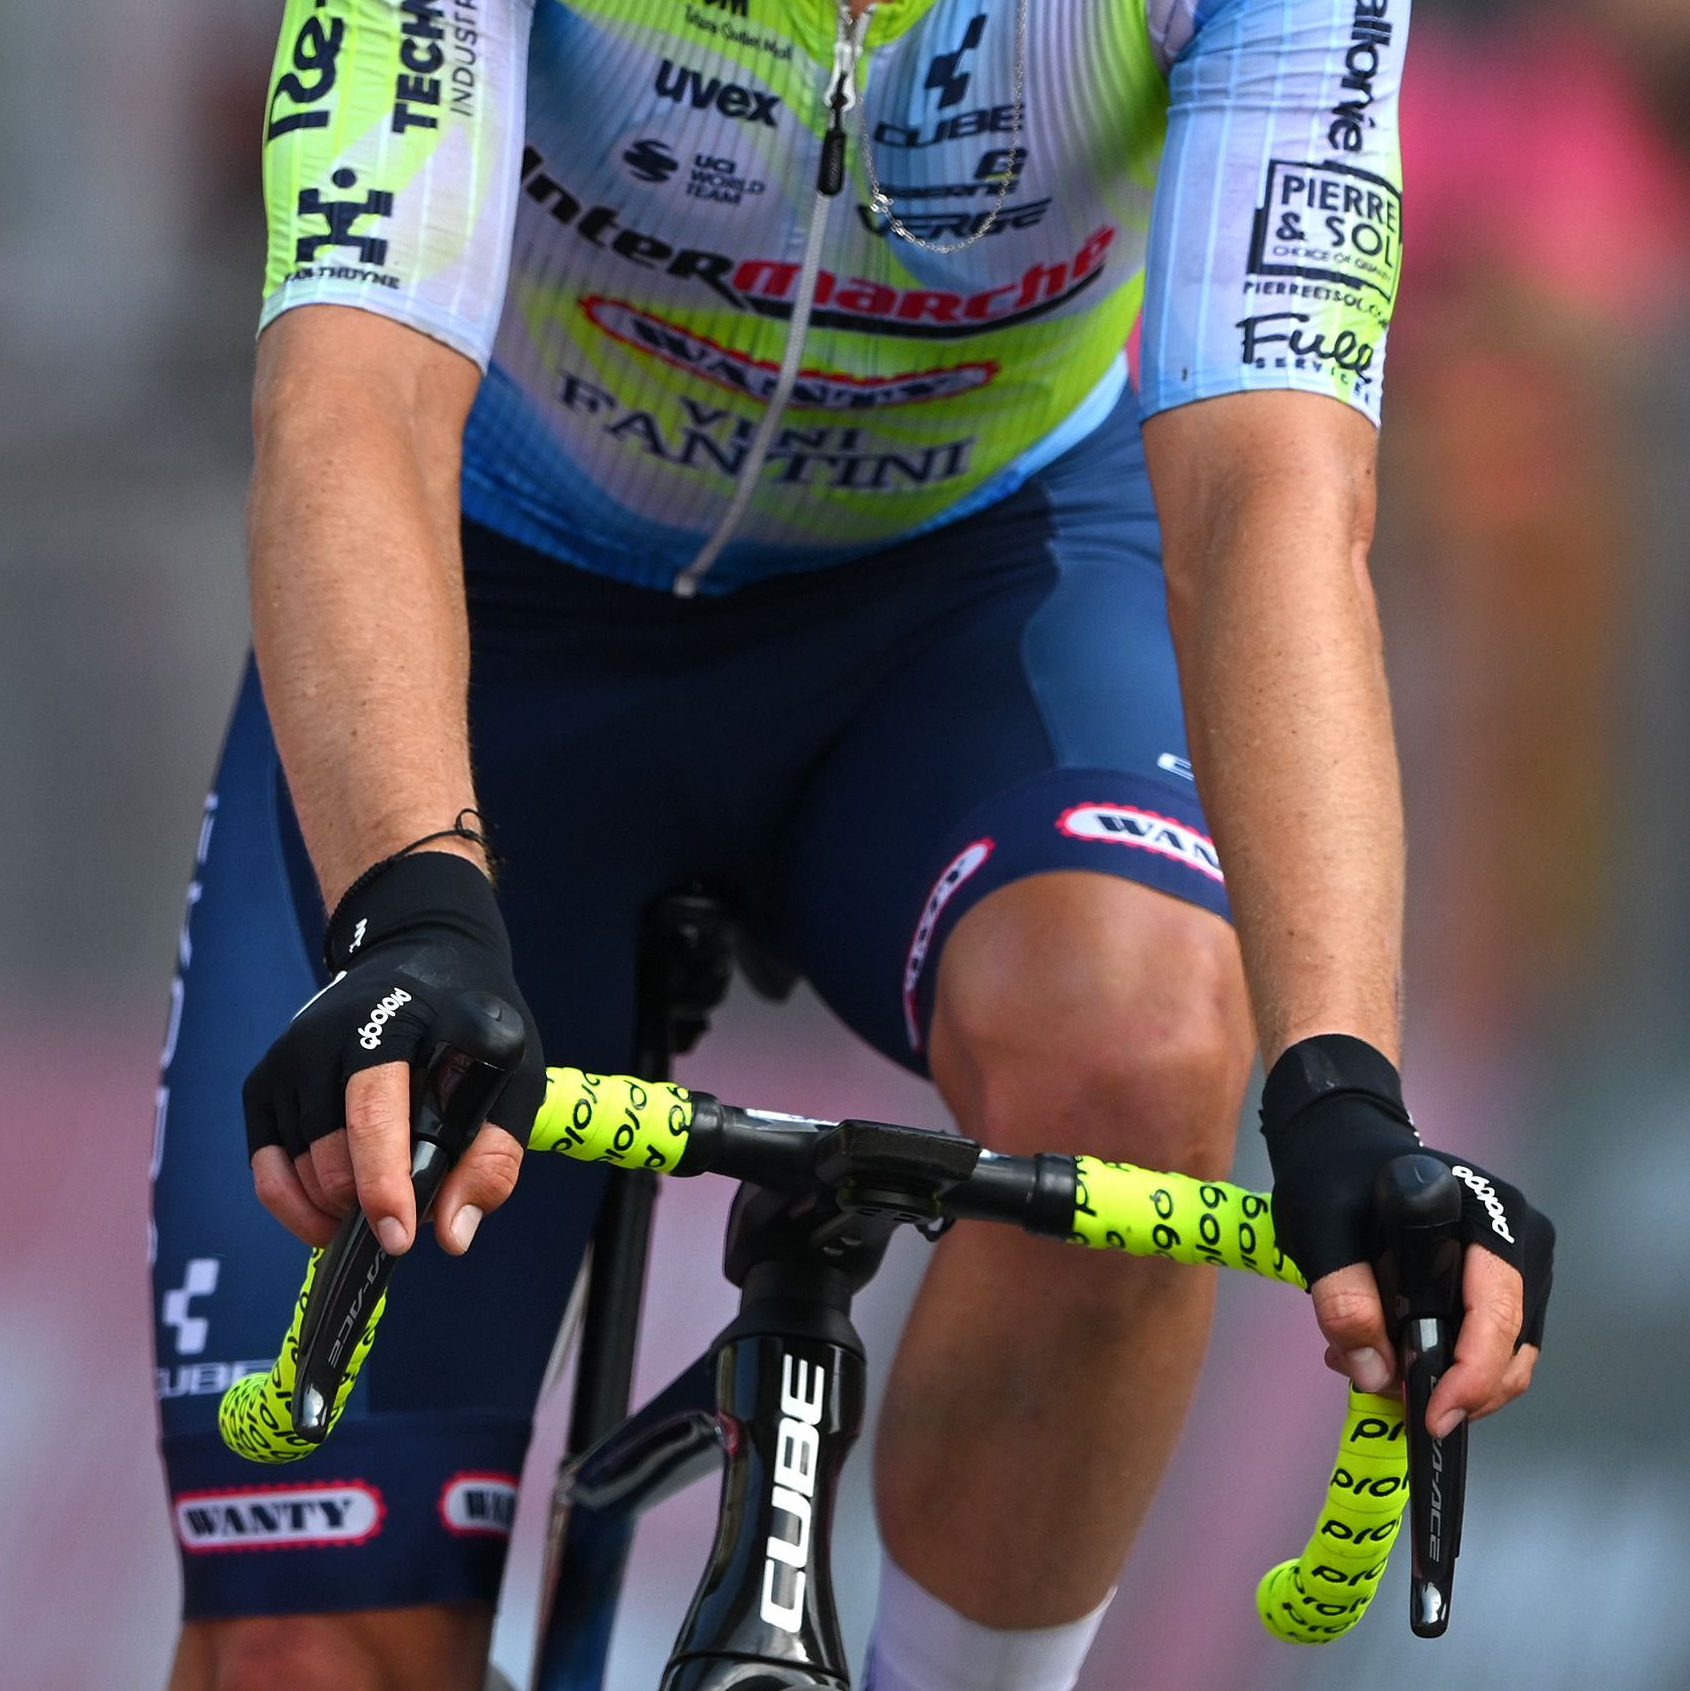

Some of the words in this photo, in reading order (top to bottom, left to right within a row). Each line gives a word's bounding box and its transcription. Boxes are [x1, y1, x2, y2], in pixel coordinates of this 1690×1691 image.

[655, 59, 780, 127] uvex
[874, 103, 1025, 148] CUBE
[686, 182, 744, 205] TEAM
[691, 170, 766, 195] WORLD
[1281, 175, 1395, 233] PIERRE
[1276, 212, 1307, 241] &
[1325, 216, 1394, 269] SOL
[1235, 312, 1374, 384] Full
[557, 370, 978, 490] FANTINI
[680, 395, 861, 449] VINI
[1095, 813, 1222, 870] WAN
[358, 987, 412, 1050] prologo
[1452, 1165, 1515, 1244] prologo
[328, 1247, 387, 1369] A-ACE
[186, 1498, 352, 1537] WANTY
[760, 1353, 825, 1634] CUBE
